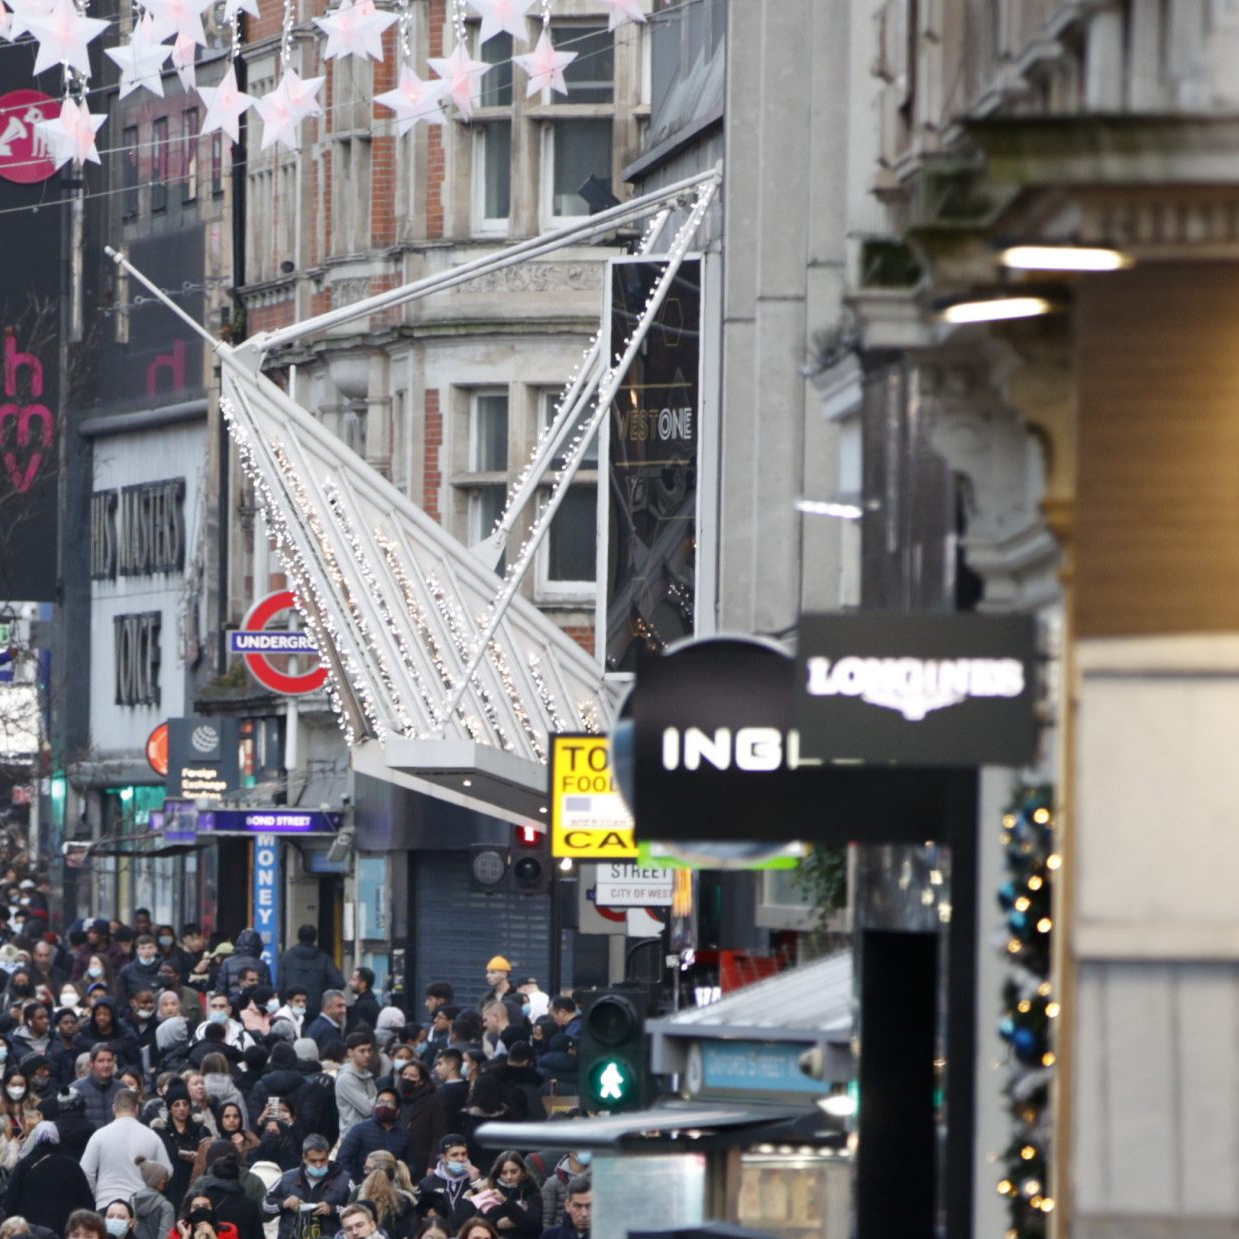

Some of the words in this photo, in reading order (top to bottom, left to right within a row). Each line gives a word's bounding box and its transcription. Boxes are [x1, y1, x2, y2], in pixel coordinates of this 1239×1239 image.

[806, 656, 1024, 696] LONGINES
[181, 768, 217, 779] Foreign
[181, 781, 227, 791] Exchange
[246, 816, 275, 827] BOND
[276, 816, 311, 827] STREET
[564, 831, 637, 849] CA
[257, 834, 274, 924] MONEY
[611, 889, 631, 899] CITY
[634, 889, 645, 899] OF
